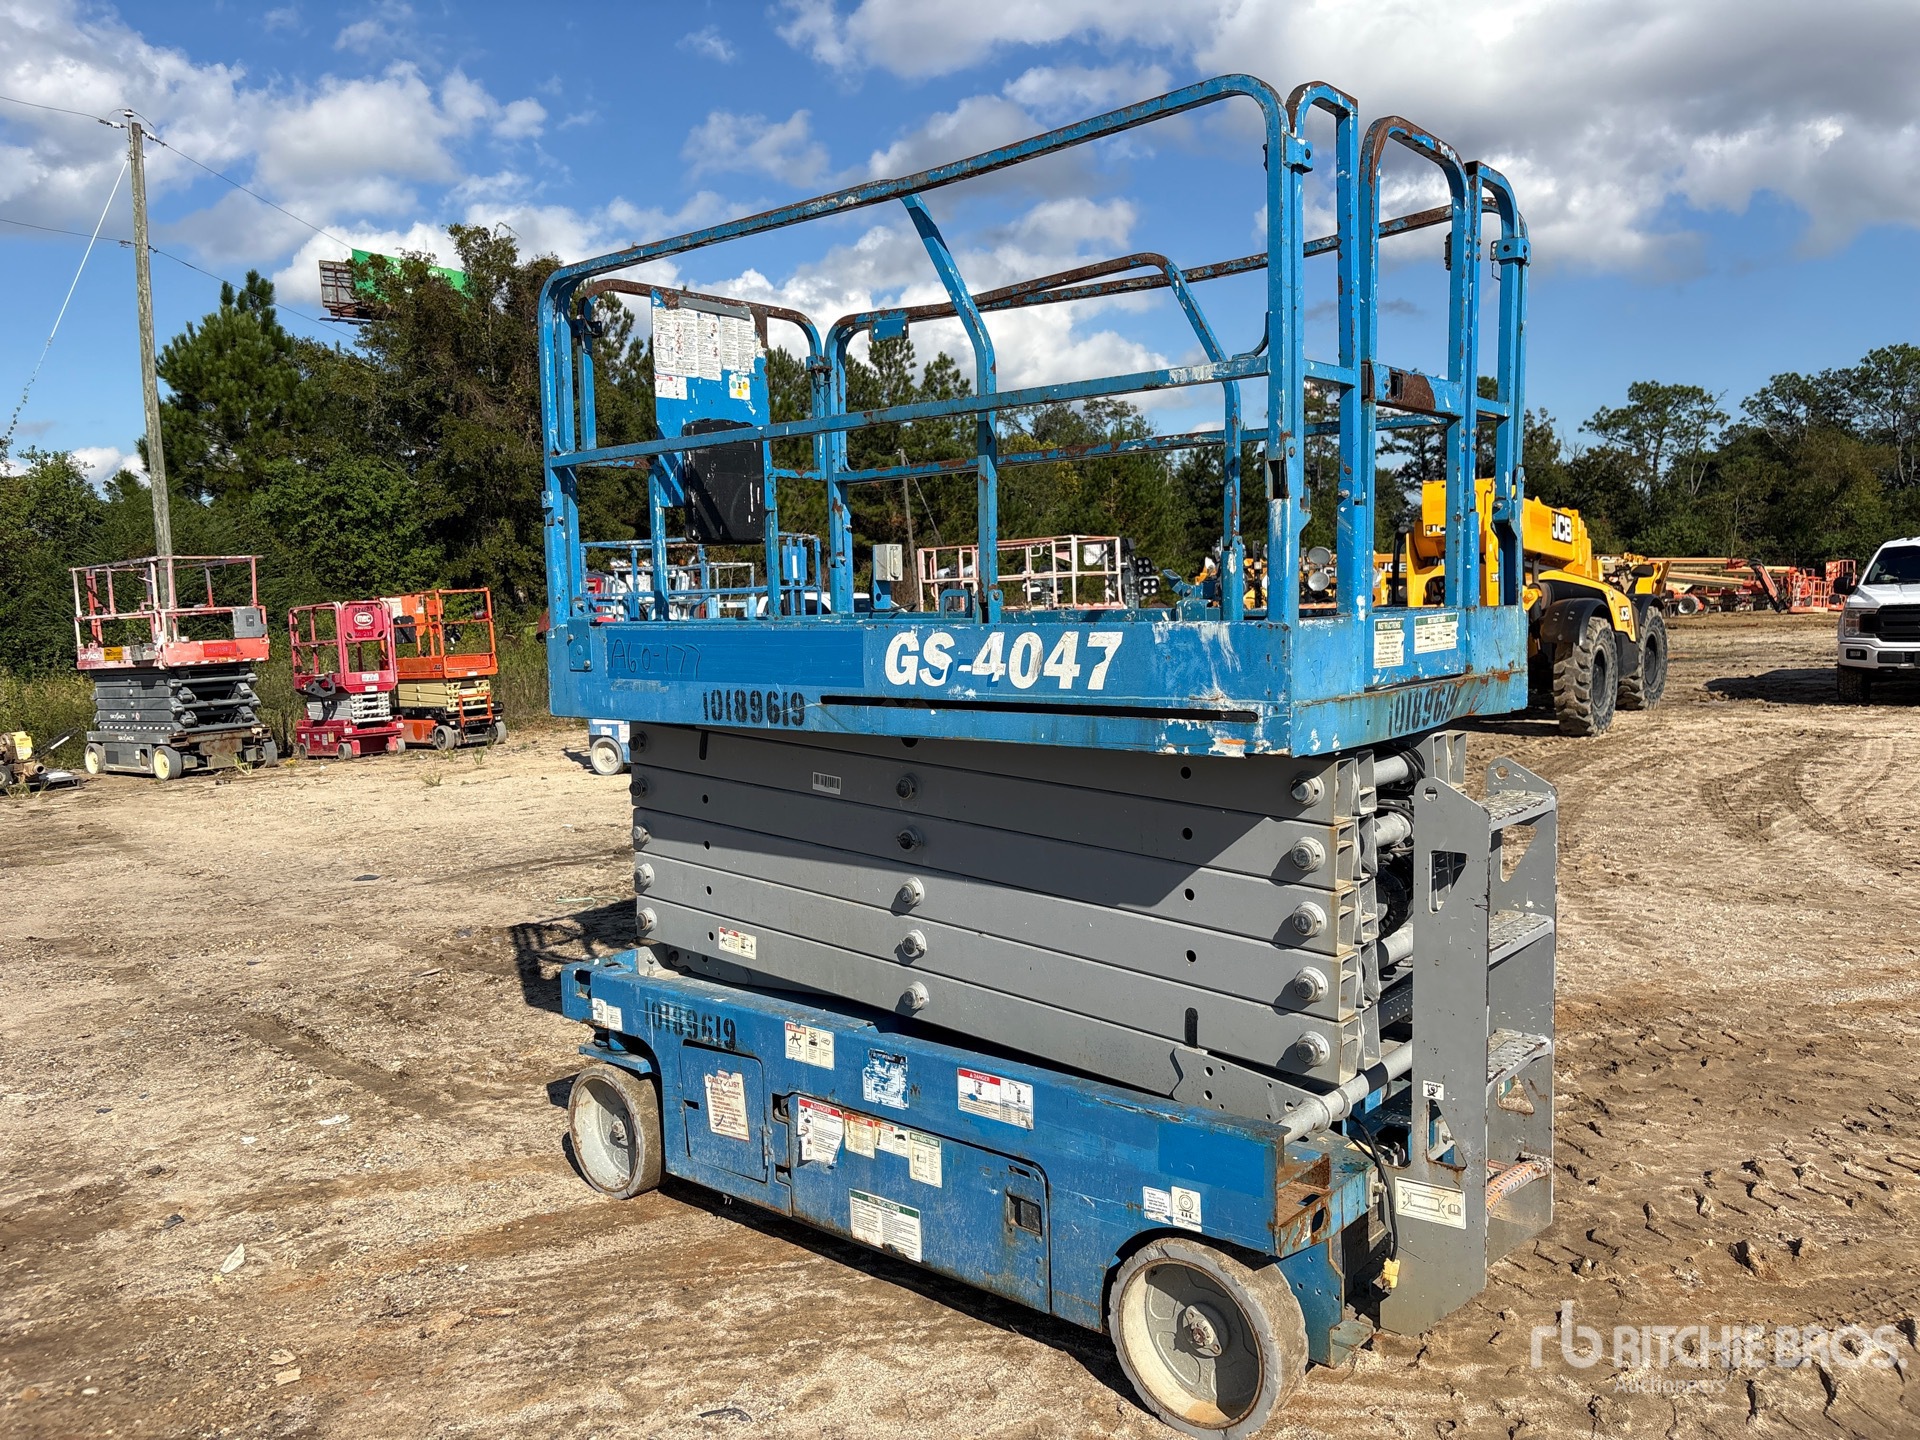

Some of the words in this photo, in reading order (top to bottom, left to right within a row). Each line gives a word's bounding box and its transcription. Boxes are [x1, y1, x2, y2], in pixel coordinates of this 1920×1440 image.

[1553, 514, 1572, 542] JCB
[611, 639, 701, 682] A60-177
[884, 631, 1124, 691] GS-4047
[702, 689, 805, 727] 10189619
[1388, 685, 1460, 736] 10189619
[644, 997, 736, 1049] 10189619
[973, 1073, 991, 1082] DANGER
[813, 1103, 832, 1114] DANGER
